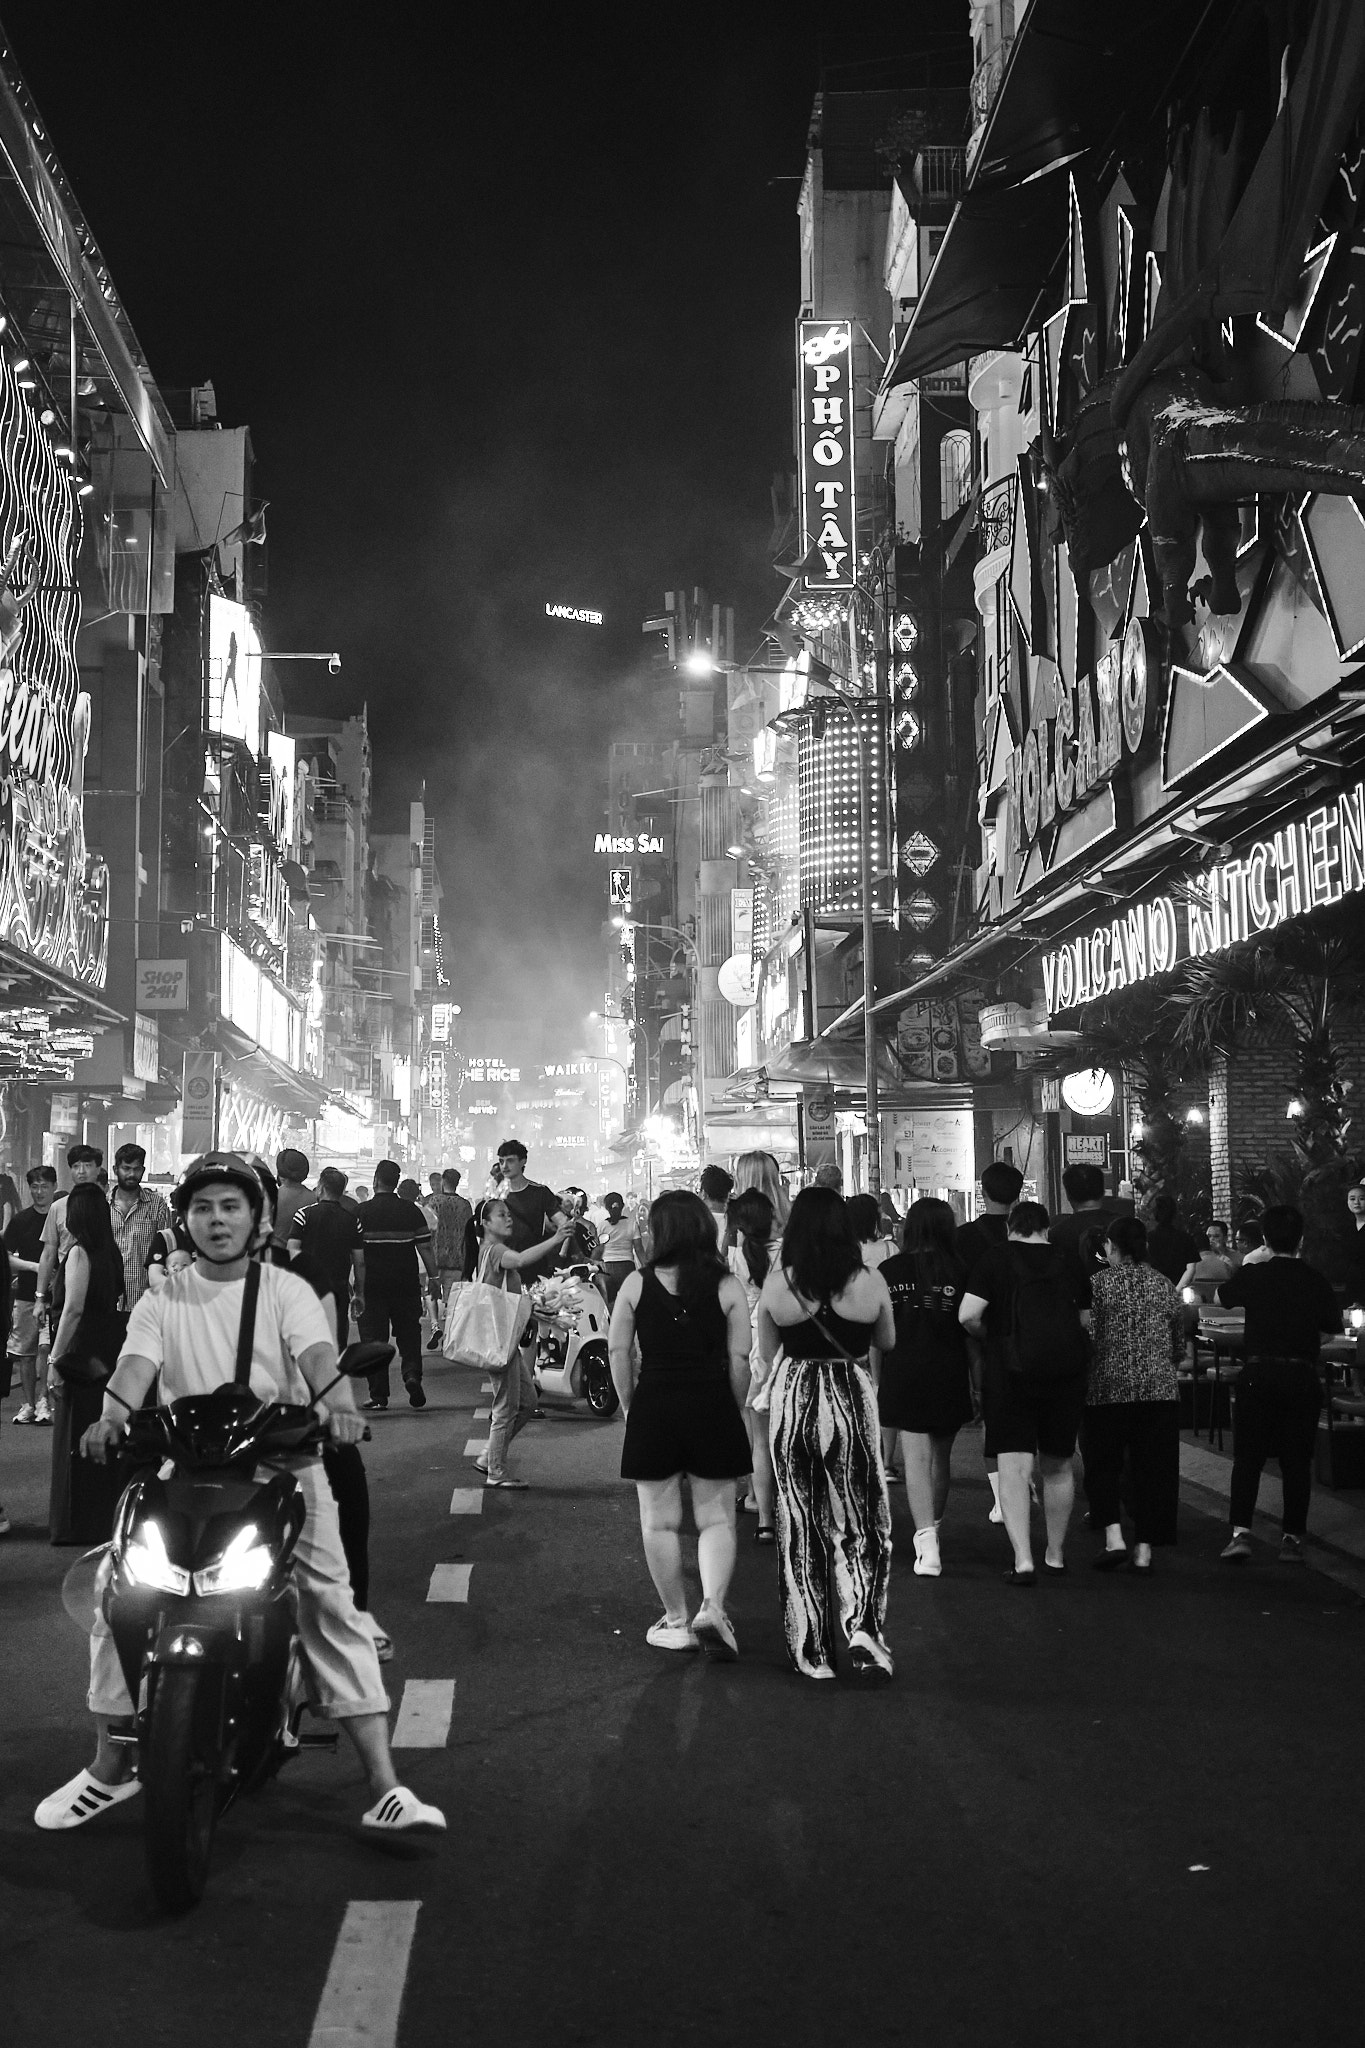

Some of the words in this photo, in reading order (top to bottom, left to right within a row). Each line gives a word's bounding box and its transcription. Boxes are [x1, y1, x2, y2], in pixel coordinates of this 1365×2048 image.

[921, 378, 966, 391] HOTEL
[811, 365, 845, 467] PHỐ
[814, 481, 848, 581] TÂY
[545, 602, 603, 625] LANCASTER
[1042, 897, 1177, 1014] VOLCANO
[1186, 782, 1365, 957] KITCHEN
[140, 971, 183, 985] SHOP
[145, 985, 178, 999] 24H
[468, 1058, 506, 1068] HOTEL
[544, 1062, 598, 1077] WAIKIKI
[486, 1068, 520, 1082] RICE
[1069, 1137, 1103, 1151] HEART
